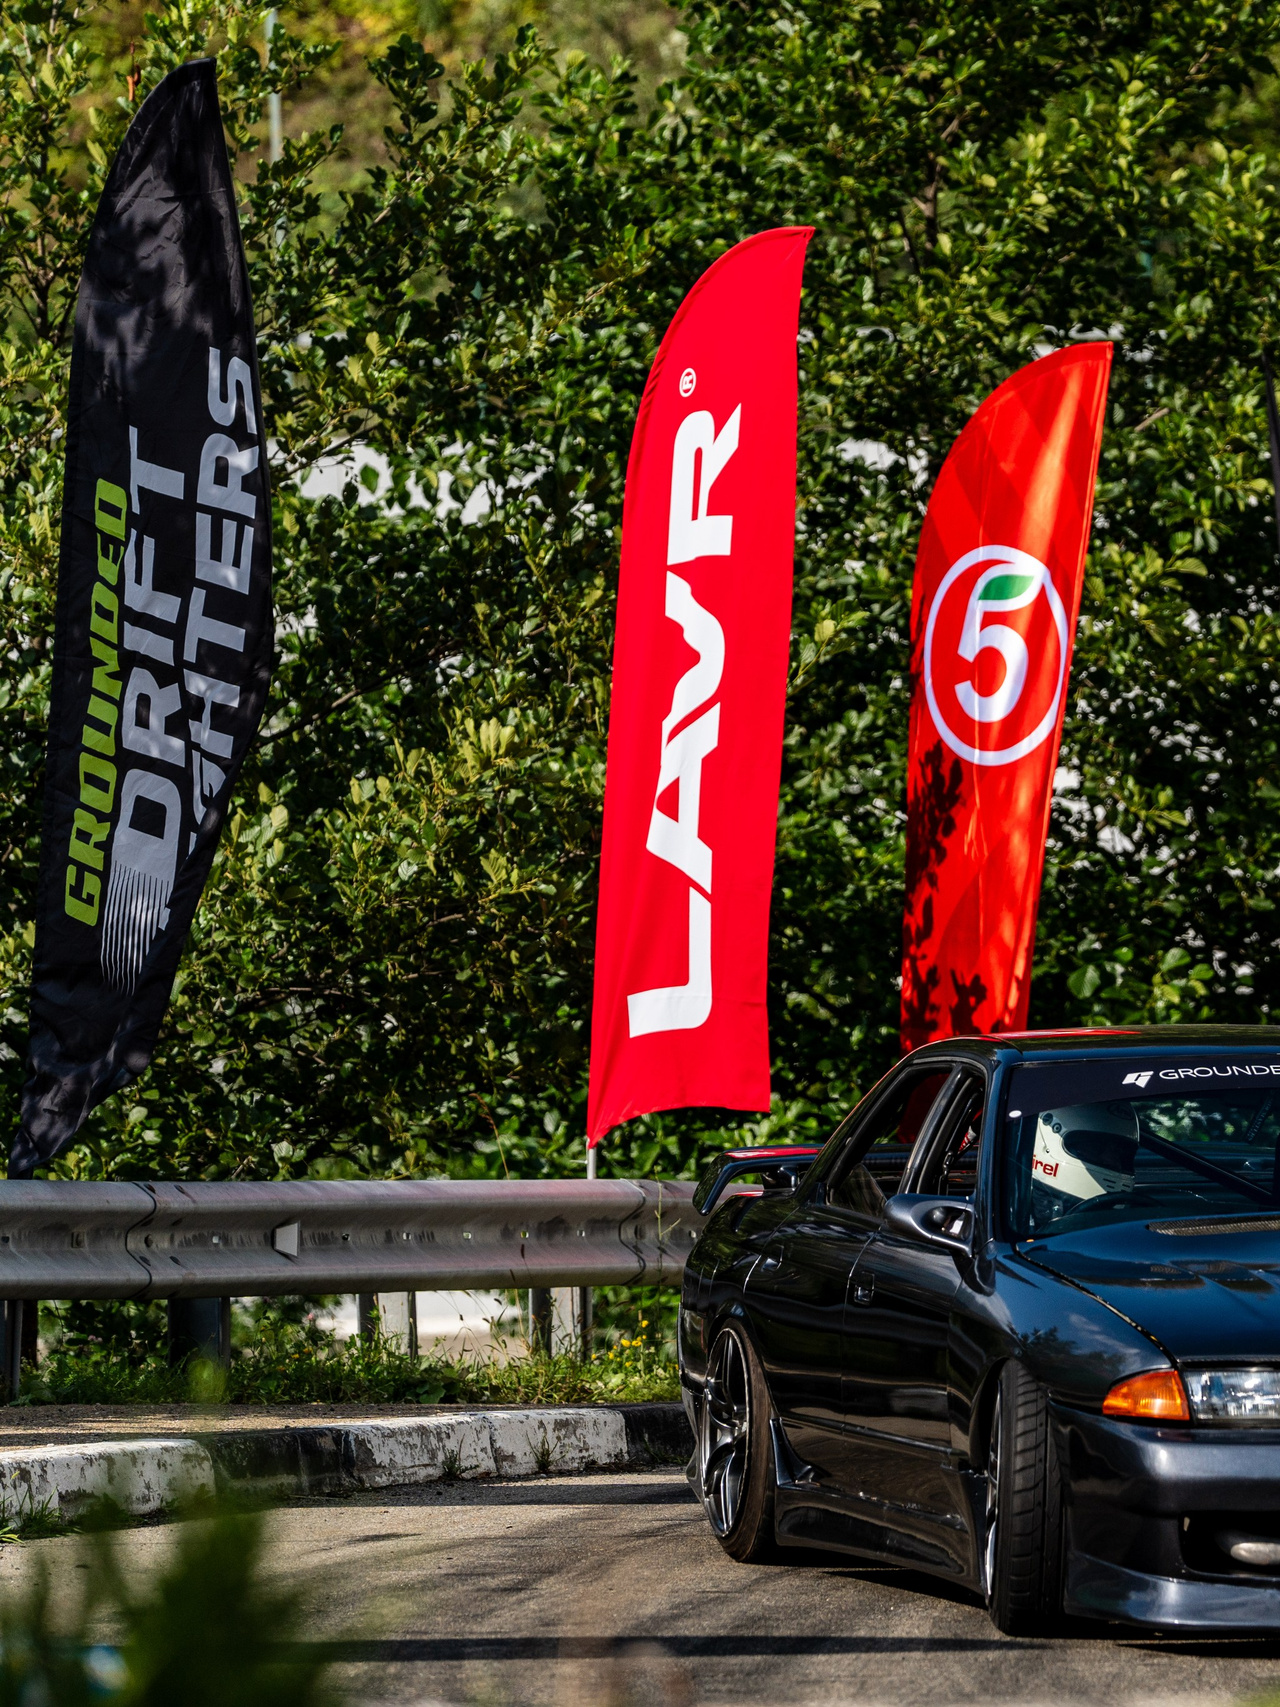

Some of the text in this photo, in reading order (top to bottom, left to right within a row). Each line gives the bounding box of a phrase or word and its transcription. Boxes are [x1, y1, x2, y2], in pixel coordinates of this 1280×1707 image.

[65, 478, 128, 927] GROUNDED
[109, 425, 185, 885] DRIFT
[176, 346, 260, 865] GHTERS
[954, 563, 1038, 722] 5
